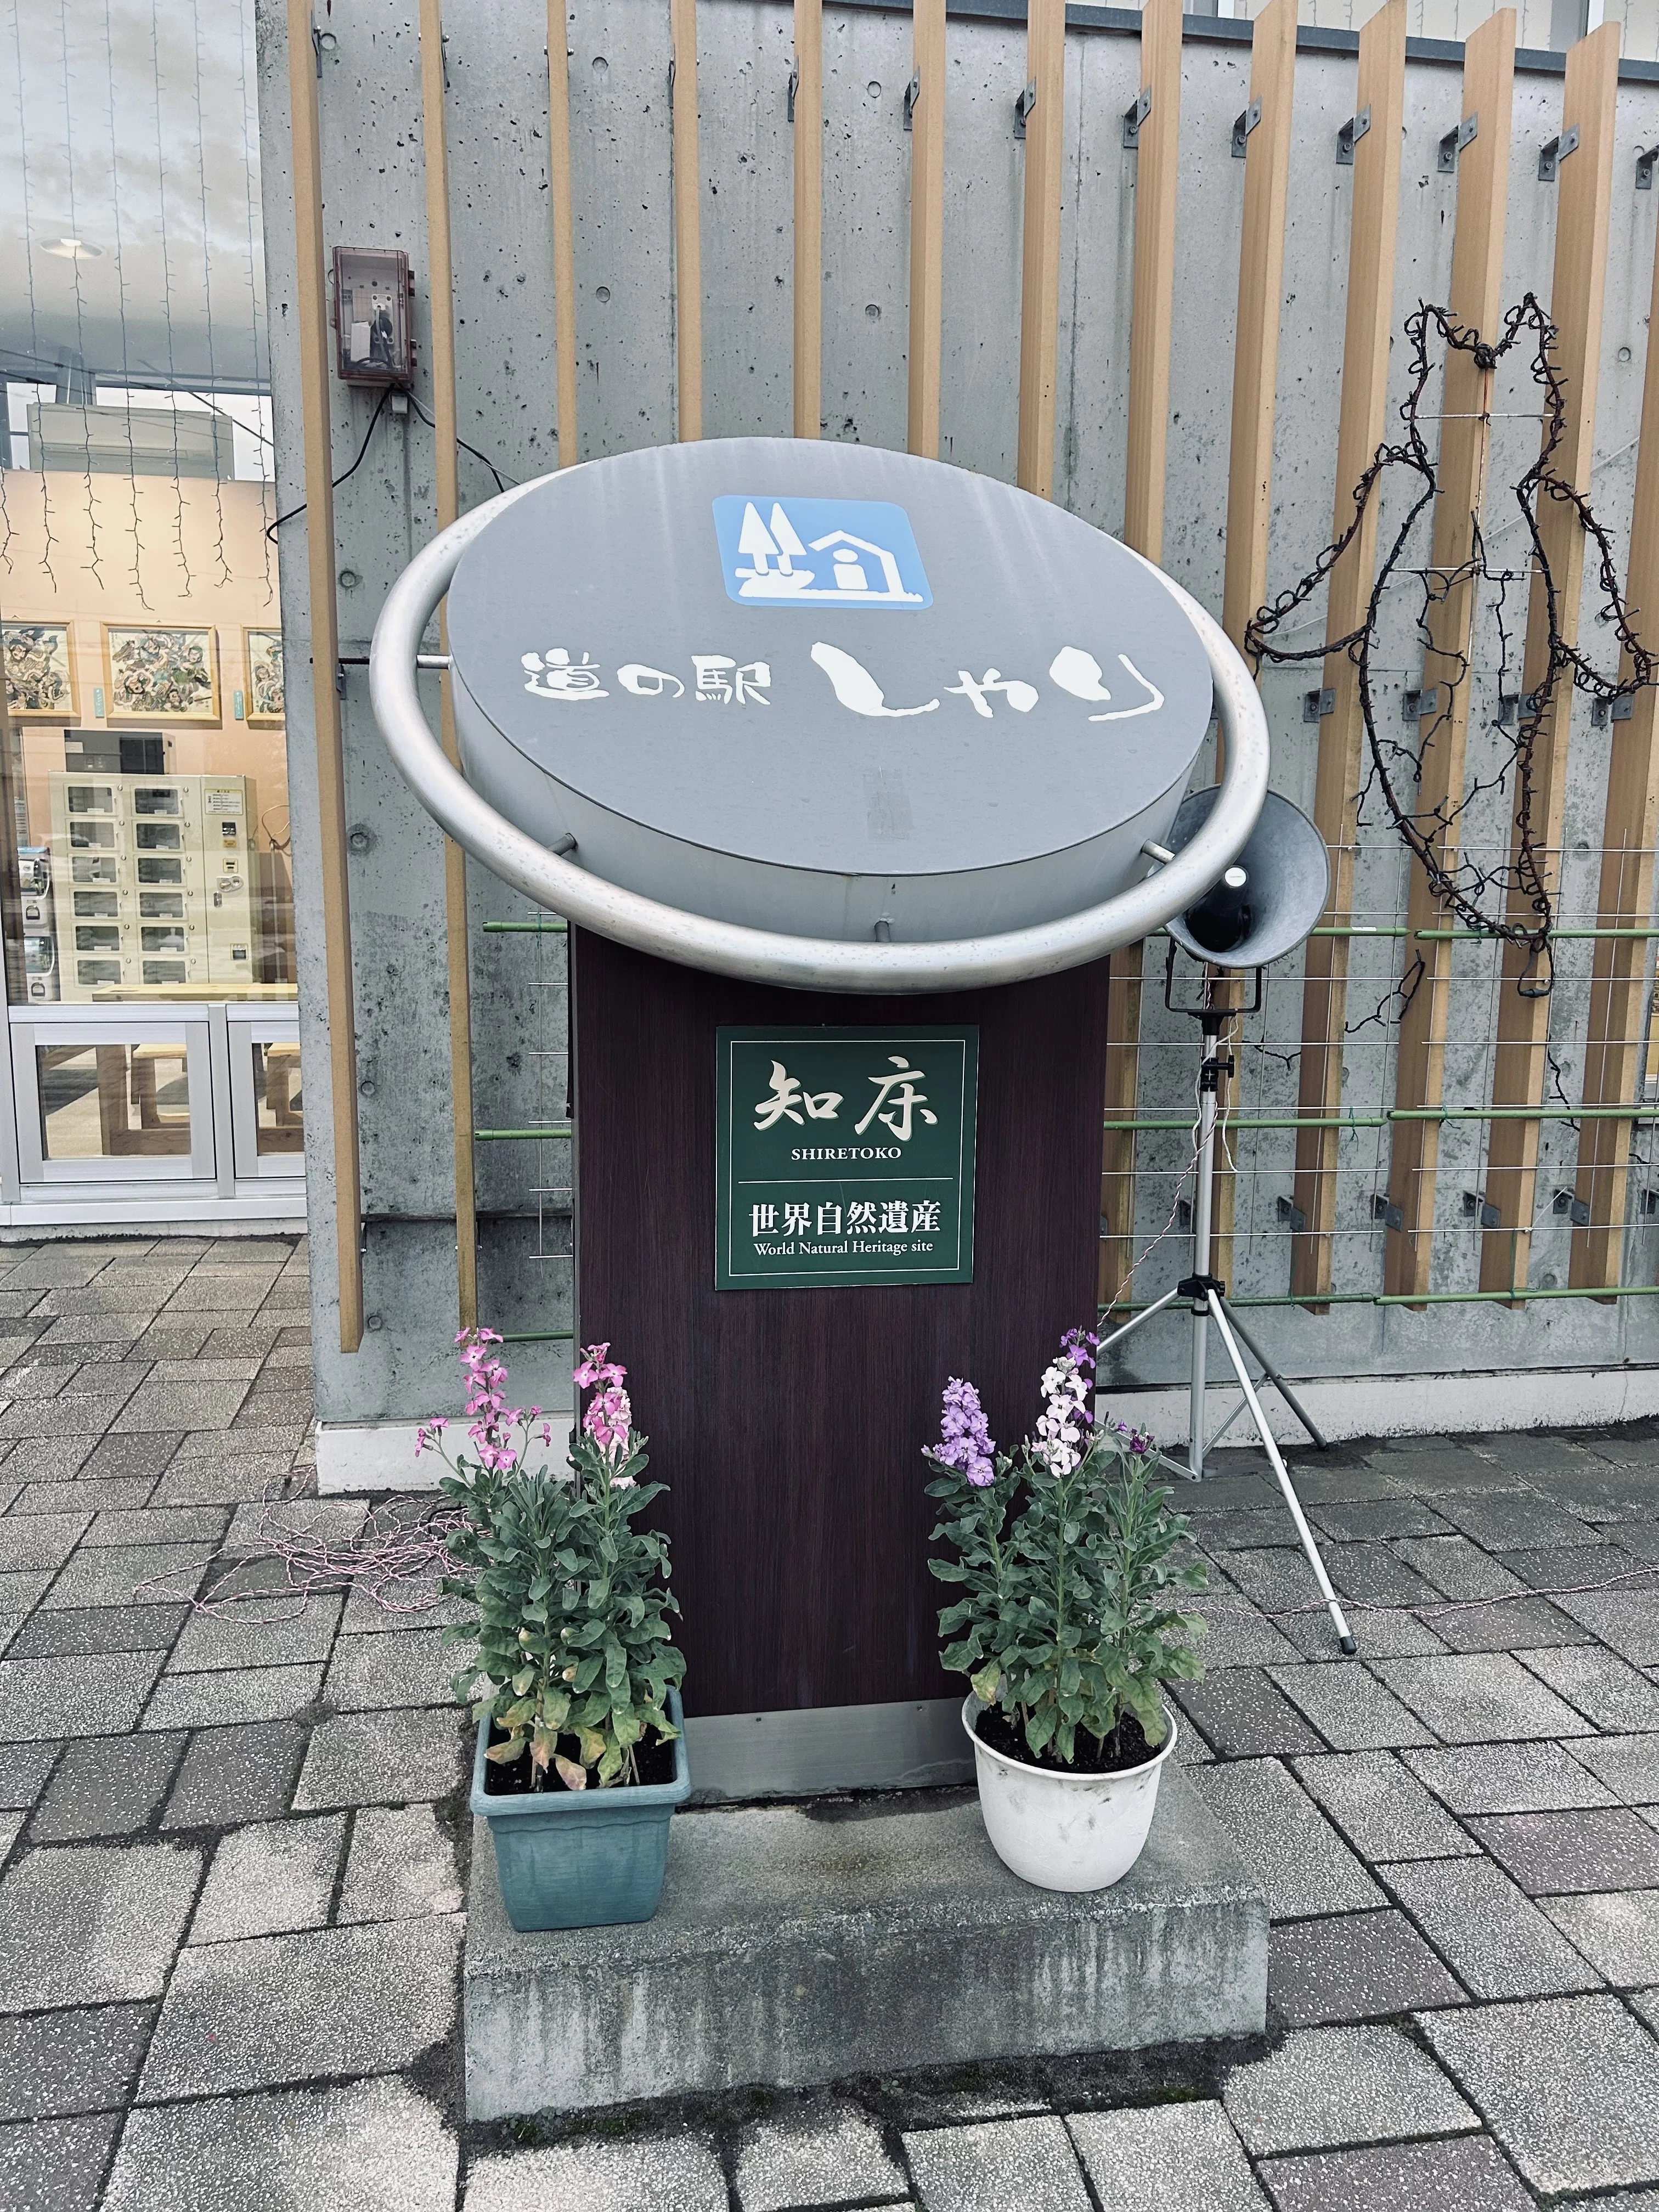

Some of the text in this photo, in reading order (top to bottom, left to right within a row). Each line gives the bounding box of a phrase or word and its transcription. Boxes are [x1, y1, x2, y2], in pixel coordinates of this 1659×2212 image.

[521, 641, 1165, 721] 道の駅 しゃり
[753, 1056, 938, 1142] 知床
[791, 1147, 901, 1160] SHIRETOKO
[748, 1200, 941, 1237] 世界自然遺産
[753, 1239, 933, 1256] World Natural Heritage site
